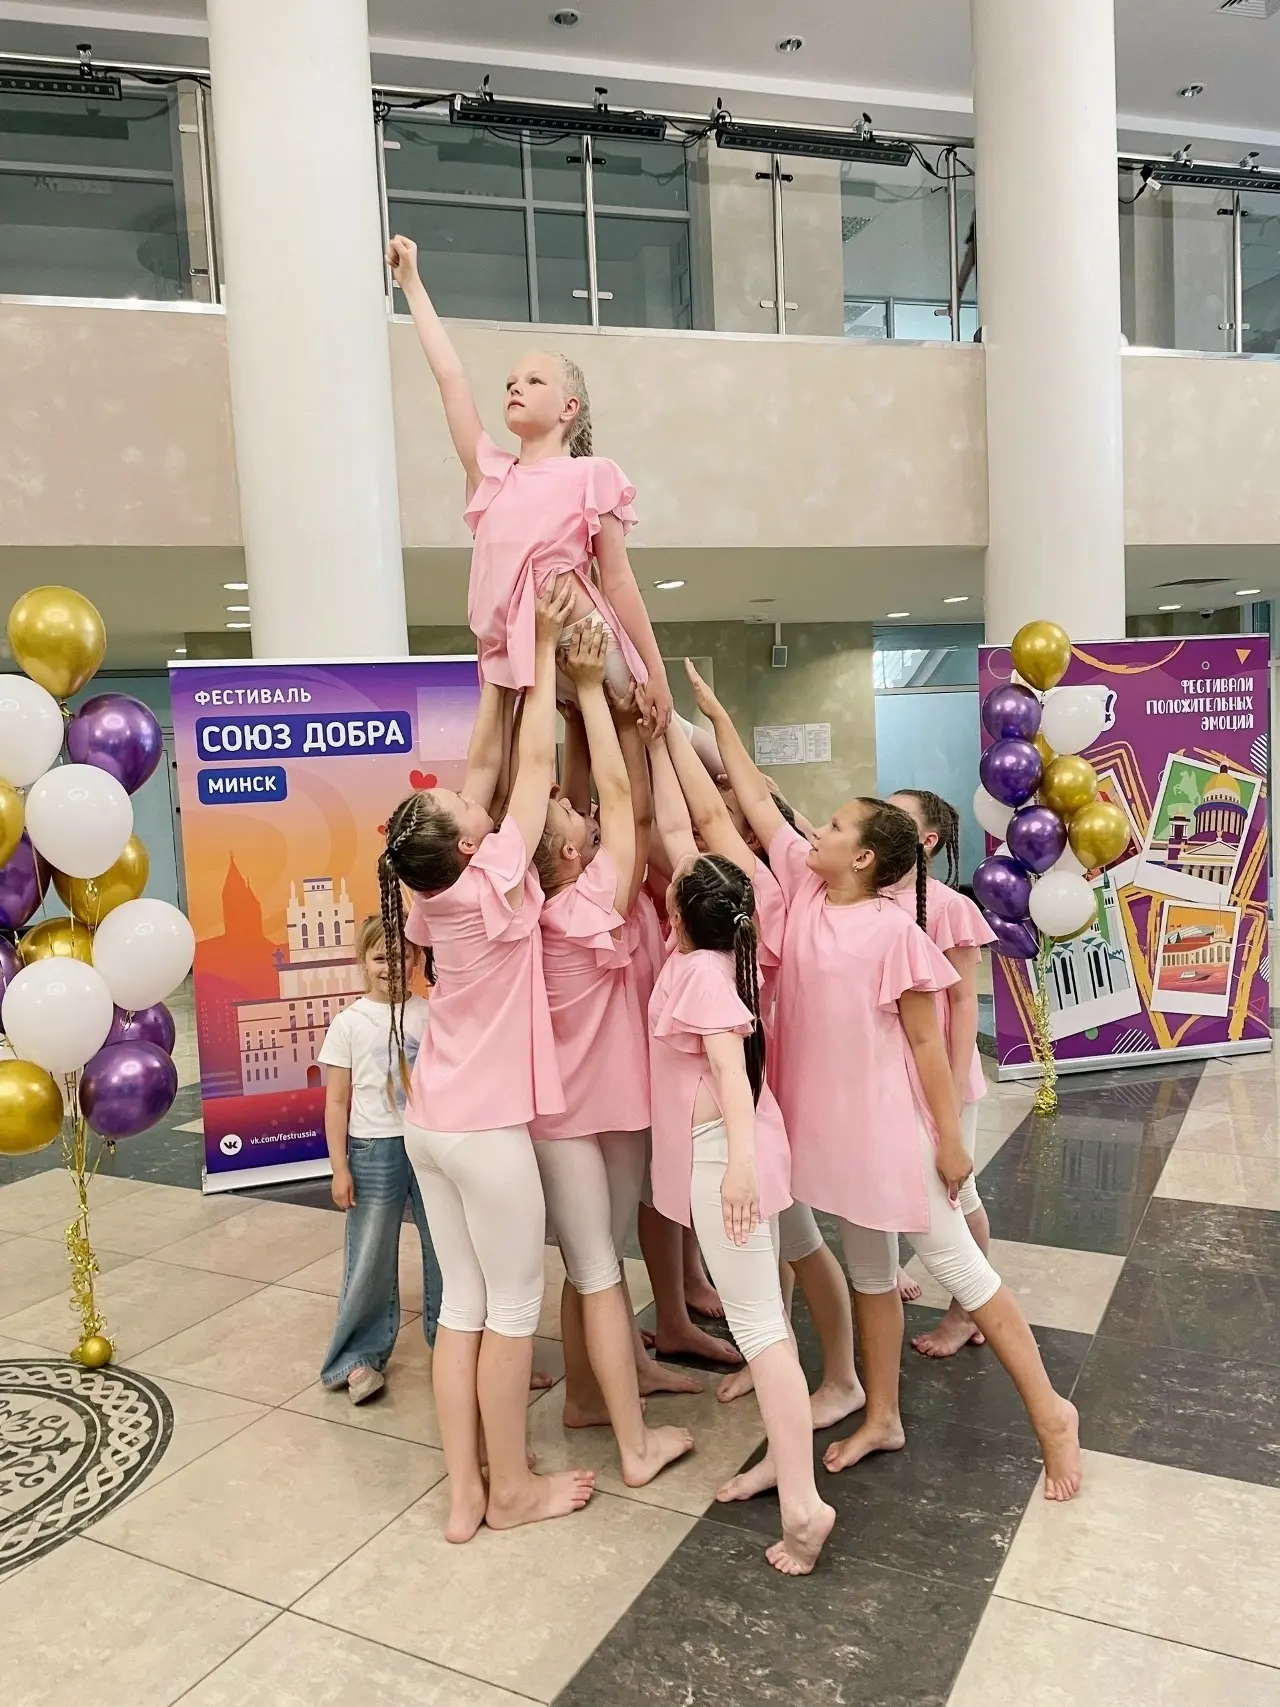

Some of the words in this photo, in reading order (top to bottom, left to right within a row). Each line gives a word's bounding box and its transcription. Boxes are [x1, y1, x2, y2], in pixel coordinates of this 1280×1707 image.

[1181, 677, 1253, 694] ФЕСТИВАЛИ
[194, 688, 312, 705] ФЕСТИВАЛЬ
[1146, 696, 1253, 714] ПОЛОЖИТЕЛЬНЫХ
[1201, 714, 1254, 731] ЭМОЦИЙ
[202, 724, 292, 752] СОЮЗ
[303, 719, 405, 753] ДОБРА
[208, 775, 277, 794] МИНСК
[250, 1129, 316, 1145] vk.com/festrussia
